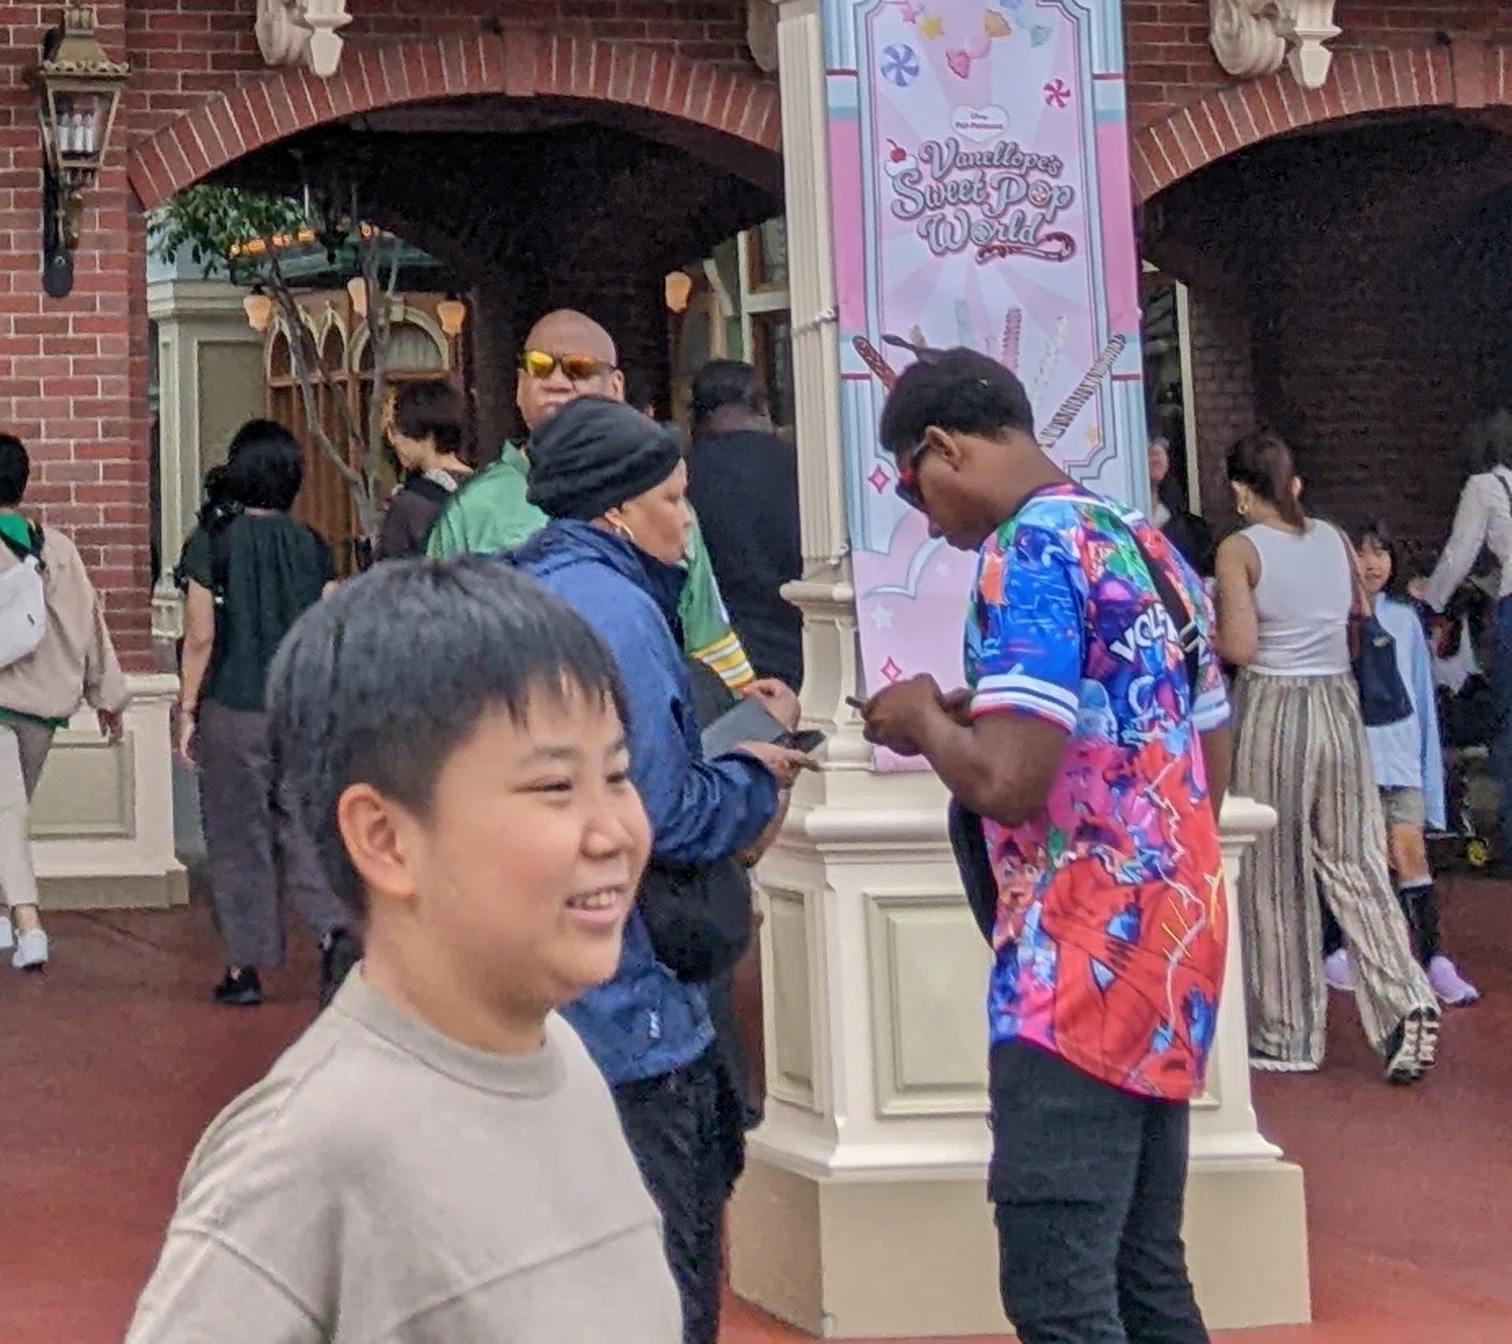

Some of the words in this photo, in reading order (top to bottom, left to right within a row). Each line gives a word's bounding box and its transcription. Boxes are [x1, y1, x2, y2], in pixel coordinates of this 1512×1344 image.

[918, 137, 1064, 180] Vanellope's
[890, 167, 990, 220] Sweet
[981, 171, 1075, 224] Pop
[916, 208, 1046, 257] World
